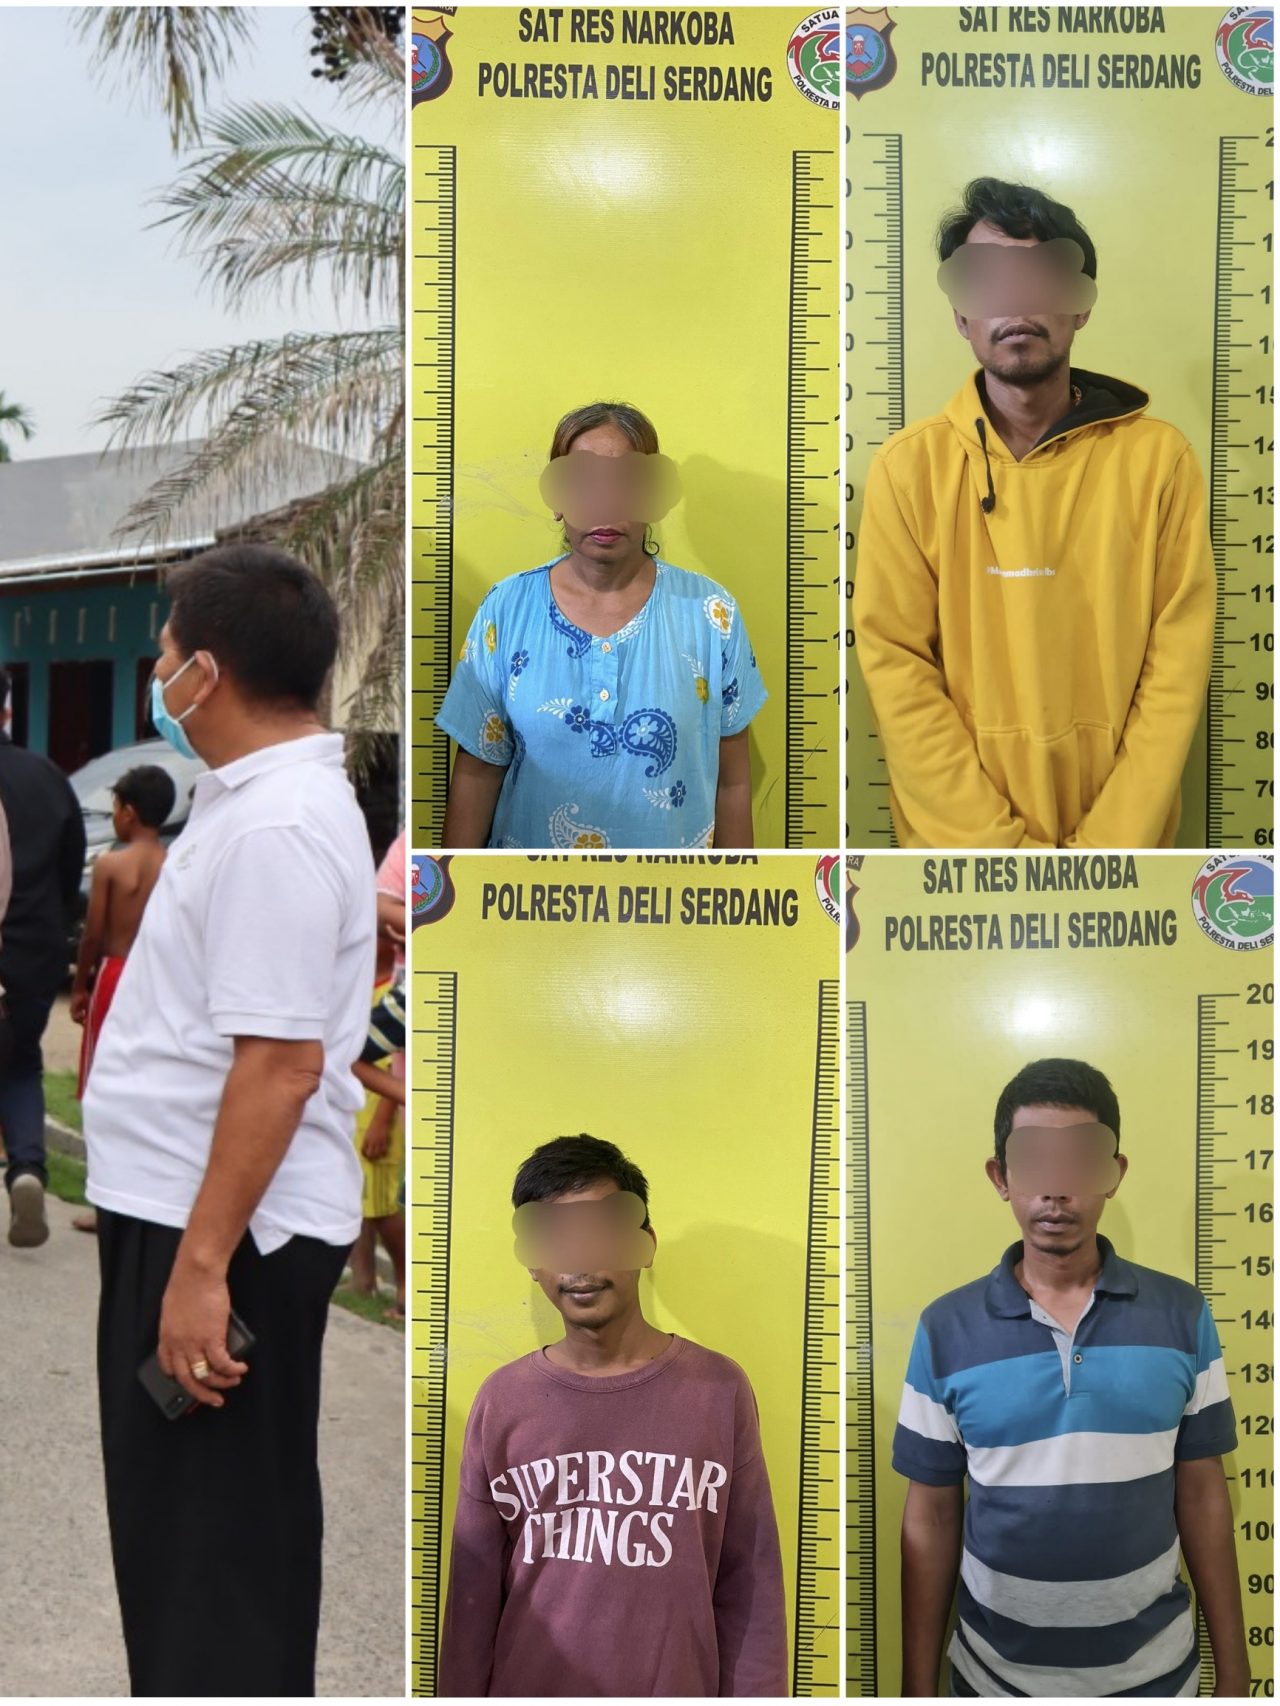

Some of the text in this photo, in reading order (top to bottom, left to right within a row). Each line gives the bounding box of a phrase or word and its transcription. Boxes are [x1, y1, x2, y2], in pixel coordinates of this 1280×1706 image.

[518, 8, 735, 46] SAT RES NARKOBA
[959, 6, 1166, 34] SAT RES NARKOBA
[478, 62, 773, 102] POLRESTA DELI SERDANG
[921, 51, 1202, 90] POLRESTA DELI SERDANG
[1222, 62, 1255, 94] POLRESTA
[793, 74, 830, 109] POLRESTA
[923, 856, 1139, 895] SAT RES NARKOBA
[481, 883, 799, 927] POLRESTA DELI SERDANG
[885, 909, 1178, 951] POLRESTA DELI SERDANG
[1199, 916, 1235, 949] POLRESTA
[1237, 941, 1258, 950] DELI
[1245, 1094, 1274, 1115] 18
[1245, 1149, 1274, 1170] 17
[1244, 1203, 1274, 1223] 16
[489, 1450, 728, 1522] SUPERSTAR
[523, 1507, 674, 1568] THINGS
[1248, 1574, 1274, 1594] 90
[1248, 1626, 1274, 1647] 80
